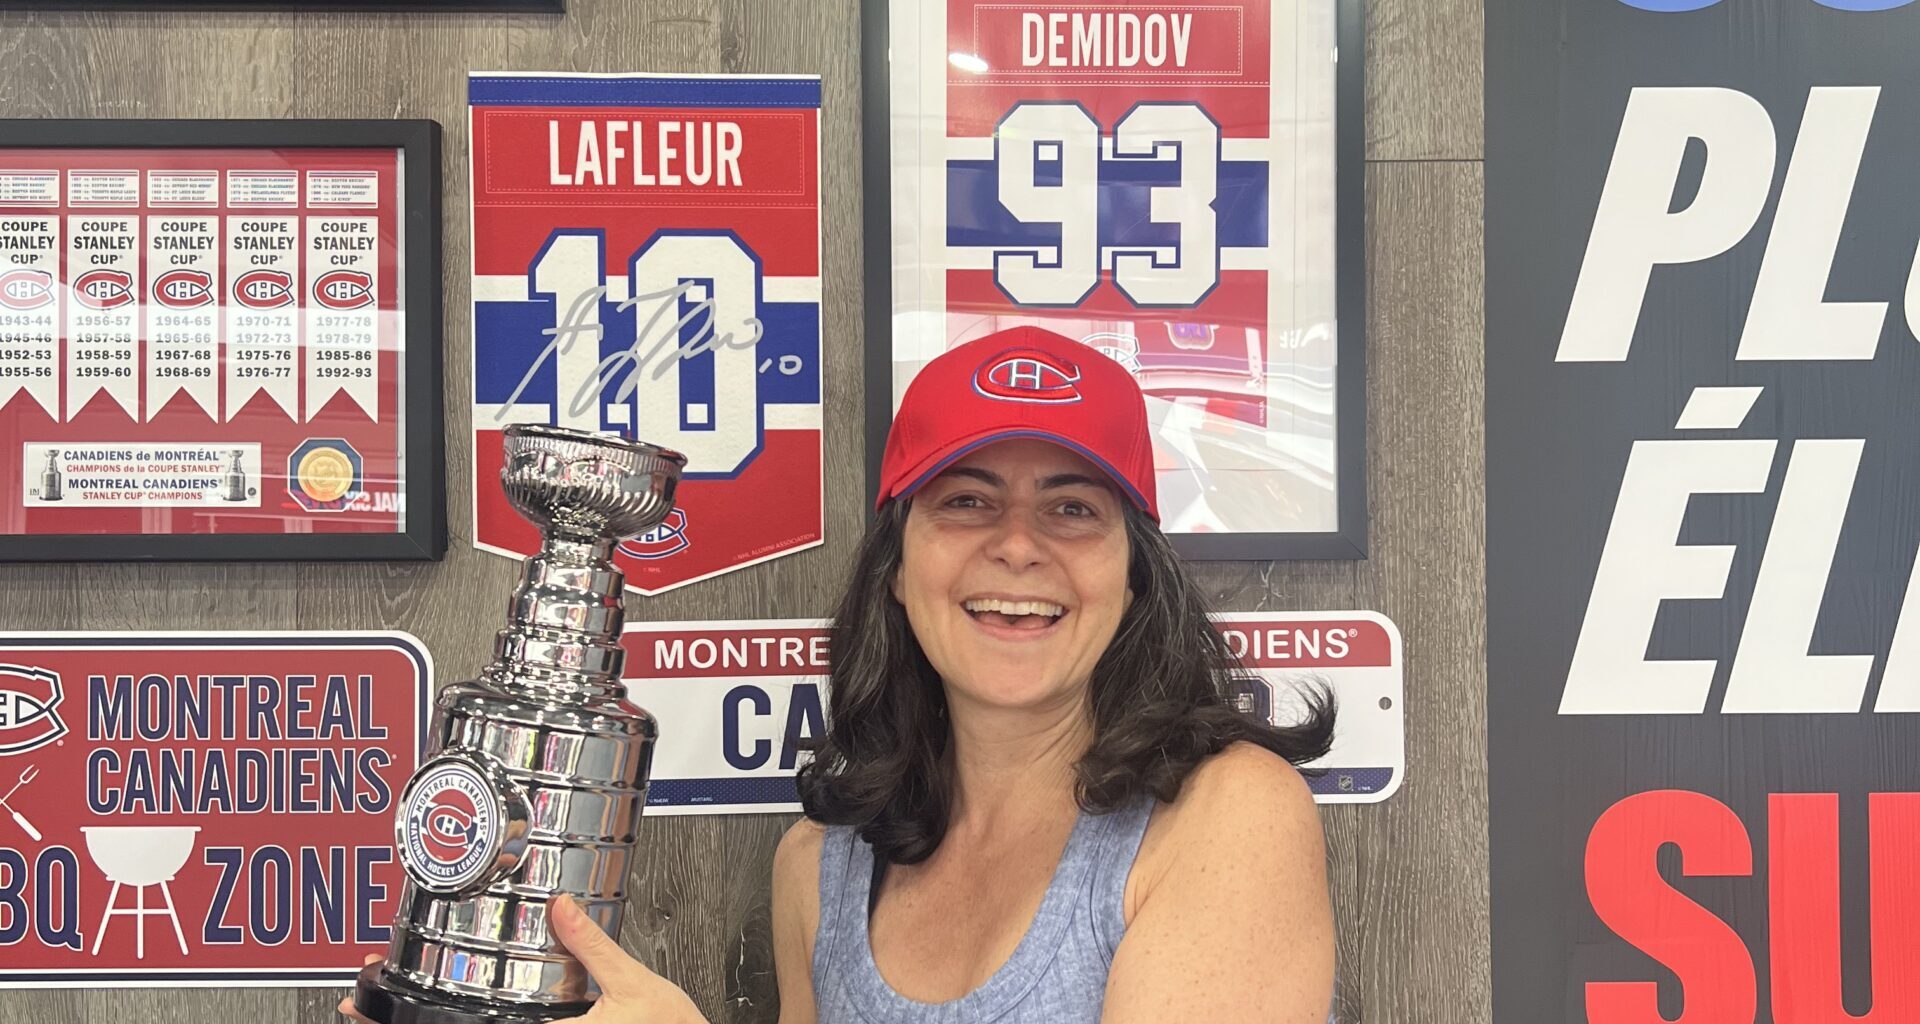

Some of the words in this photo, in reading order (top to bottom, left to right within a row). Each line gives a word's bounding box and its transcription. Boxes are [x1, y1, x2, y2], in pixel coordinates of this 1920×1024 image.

[1022, 13, 1192, 67] DEMIDOV
[549, 120, 743, 186] LAFLEUR
[993, 99, 1222, 309] 93
[2, 222, 48, 232] COUPE
[81, 222, 128, 232] COUPE
[161, 222, 207, 232] COUPE
[241, 222, 288, 232] COUPE
[321, 222, 368, 232] COUPE
[1554, 86, 1920, 362] PL
[74, 236, 135, 250] STANLEY
[153, 236, 214, 250] STANLEY
[234, 236, 295, 250] STANLEY
[314, 236, 375, 250] STANLEY
[76, 316, 132, 326] 1956-57
[155, 316, 212, 326] 1964-65
[236, 316, 292, 326] 1970-71
[316, 316, 372, 326] 1977-78
[76, 333, 132, 343] 1957-58
[155, 333, 212, 343] 1965-66
[236, 333, 292, 343] 1972-73
[316, 333, 372, 343] 1978-79
[76, 350, 132, 360] 1958-59
[155, 350, 212, 360] 1967-68
[236, 350, 292, 360] 1975-76
[316, 350, 372, 360] 1985-86
[528, 227, 763, 479] 10
[76, 367, 132, 377] 1959-60
[155, 367, 212, 377] 1968-69
[236, 367, 292, 377] 1976-77
[316, 367, 372, 377] 1992-93
[64, 451, 132, 461] CANADIENS
[136, 451, 151, 461] de
[66, 465, 121, 473] CHAMPIONS
[123, 465, 135, 473] de
[137, 465, 145, 473] la
[147, 465, 178, 473] COUPE
[68, 479, 138, 489] MONTREAL
[82, 492, 122, 500] STANLEY
[148, 492, 202, 500] CHAMPIONS
[1557, 386, 1920, 715] ÉL
[655, 637, 831, 669] MONTRE
[88, 674, 388, 741] MONTREAL
[722, 683, 828, 771] CA
[86, 747, 392, 815] CANADIENS
[416, 777, 455, 813] MONTREAL
[459, 779, 487, 831] CANADIENS
[410, 822, 426, 866] NATIONAL
[427, 861, 455, 876] HOCKEY
[457, 846, 483, 872] LEAGUE
[0, 845, 84, 951] BQ
[203, 845, 393, 946] ZONE
